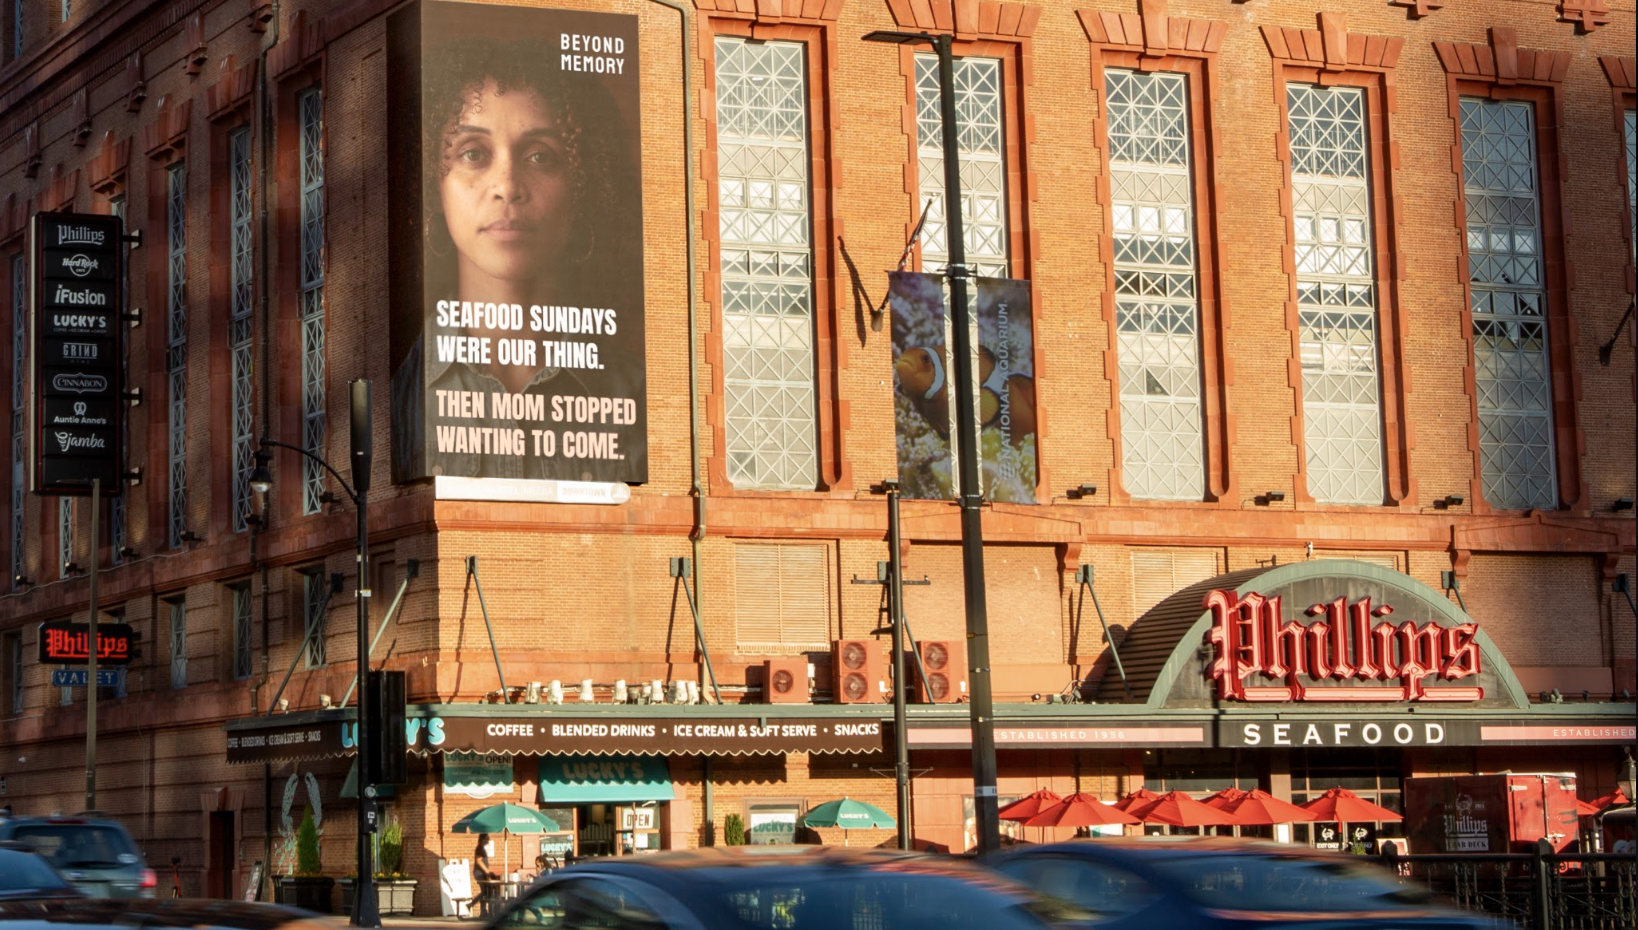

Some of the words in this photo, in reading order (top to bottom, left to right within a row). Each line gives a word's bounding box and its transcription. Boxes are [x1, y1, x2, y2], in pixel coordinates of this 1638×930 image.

[560, 33, 625, 55] BEYOND
[560, 54, 625, 75] MEMORY
[57, 224, 105, 245] Phillips
[62, 257, 81, 267] Hard
[81, 258, 99, 269] Rock
[55, 284, 106, 305] iFusion
[53, 313, 107, 328] LUCKY'S
[436, 299, 524, 331] SEAFOOD
[529, 304, 617, 336] SUNDAYS
[63, 344, 98, 357] GRIND
[436, 335, 491, 365] WERE
[498, 338, 537, 367] OUR
[542, 340, 605, 370] THING.
[57, 378, 103, 388] CINNABON
[436, 389, 485, 419] THEN
[492, 392, 545, 422] MOM
[551, 395, 637, 426] STOPPED
[54, 415, 80, 424] Auntie
[80, 416, 107, 425] Anne's
[1001, 384, 1010, 460] NATIONAL
[436, 425, 525, 456] WANTING
[531, 429, 556, 458] TO
[562, 431, 625, 460] COME.
[46, 628, 128, 658] Philips
[1206, 589, 1484, 700] Phillips
[58, 672, 114, 684] VALET
[487, 724, 534, 737] COFFEE
[552, 724, 609, 737] BLENDED
[610, 724, 656, 737] DRINKS
[673, 724, 692, 737] ICE
[695, 724, 735, 737] CREAM
[737, 724, 747, 737] &
[750, 724, 780, 737] SOFT
[782, 724, 817, 737] SERVE
[834, 722, 879, 736] SNACKS
[994, 730, 1087, 740] ESTABLISHED
[1094, 731, 1125, 740] 1956
[1244, 722, 1446, 746] SEAFOOD
[1553, 729, 1635, 737] ESTABLISHED
[445, 752, 484, 762] LUCKYS
[485, 755, 512, 764] OPEN!
[562, 761, 644, 780] LUCKY'S
[753, 821, 793, 833] LUCKY'S
